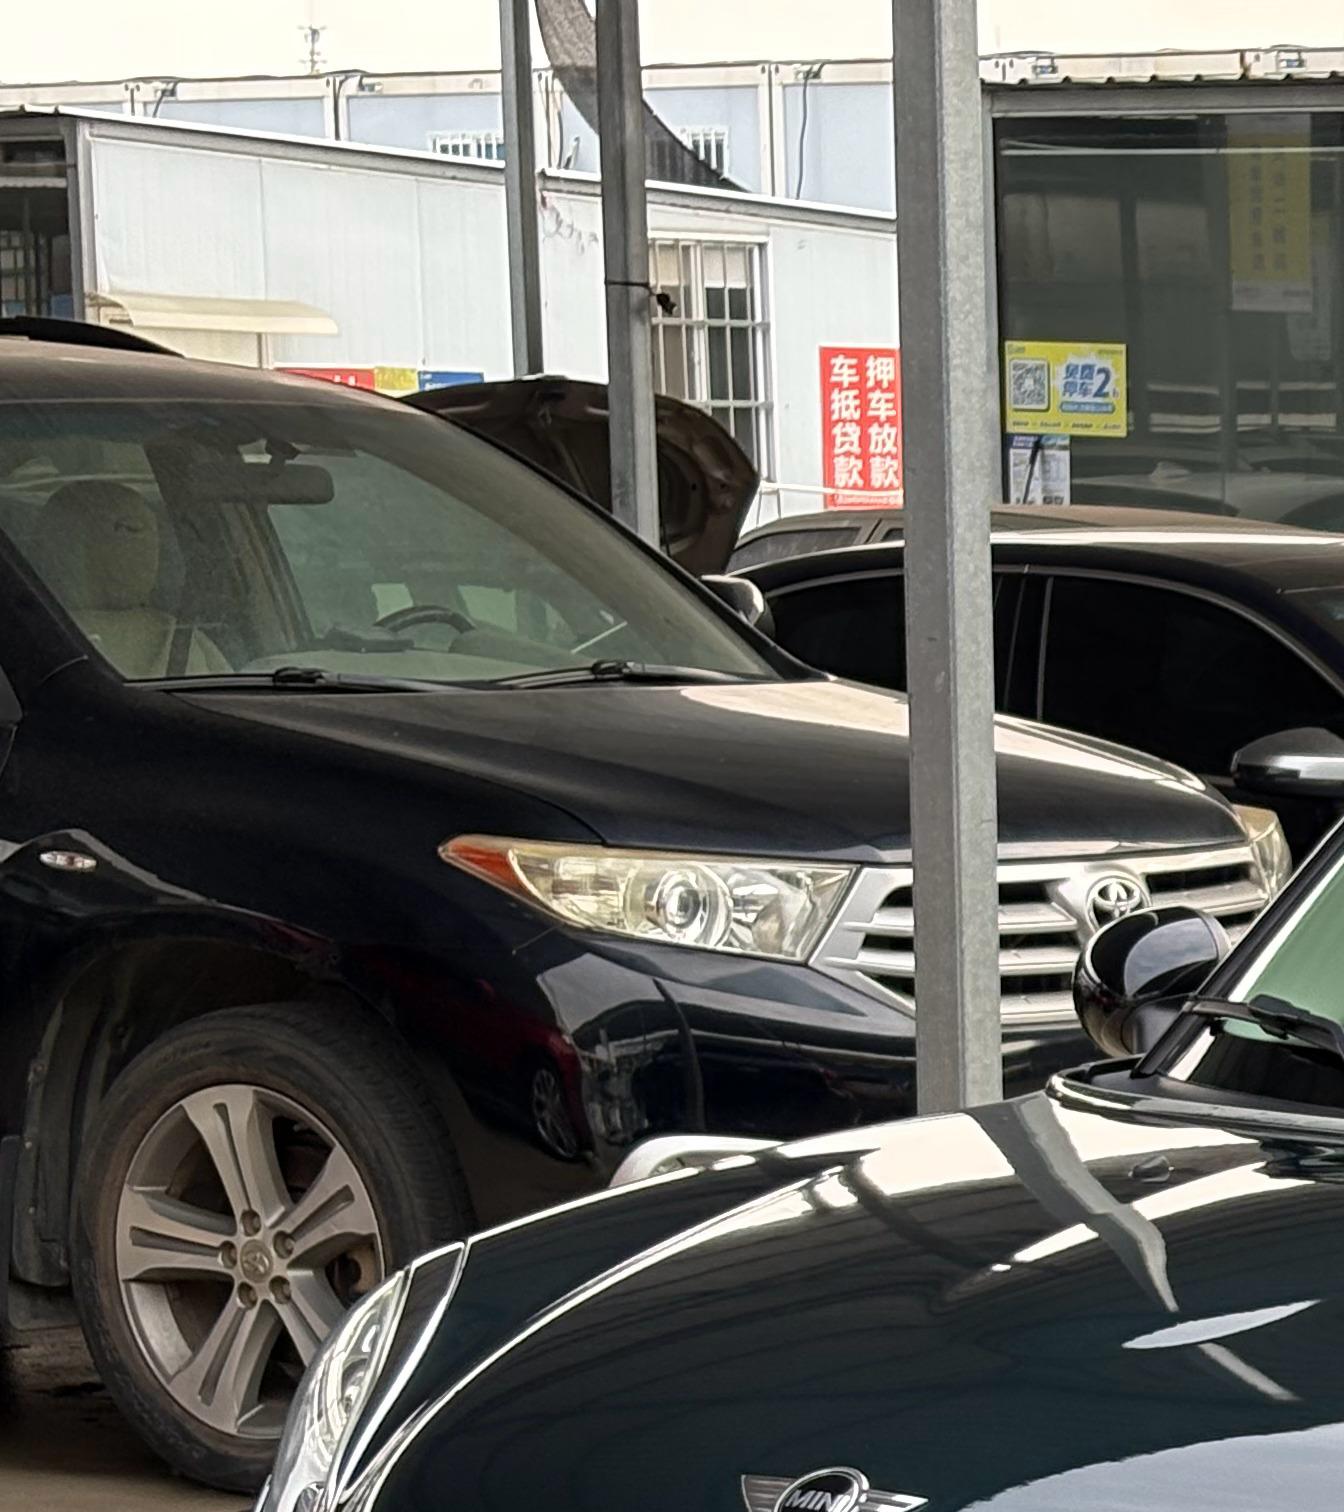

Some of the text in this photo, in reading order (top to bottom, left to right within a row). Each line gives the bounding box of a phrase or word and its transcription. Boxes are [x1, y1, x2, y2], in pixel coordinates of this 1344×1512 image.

[829, 354, 864, 489] 车抵贷款
[865, 355, 900, 490] 押车放款
